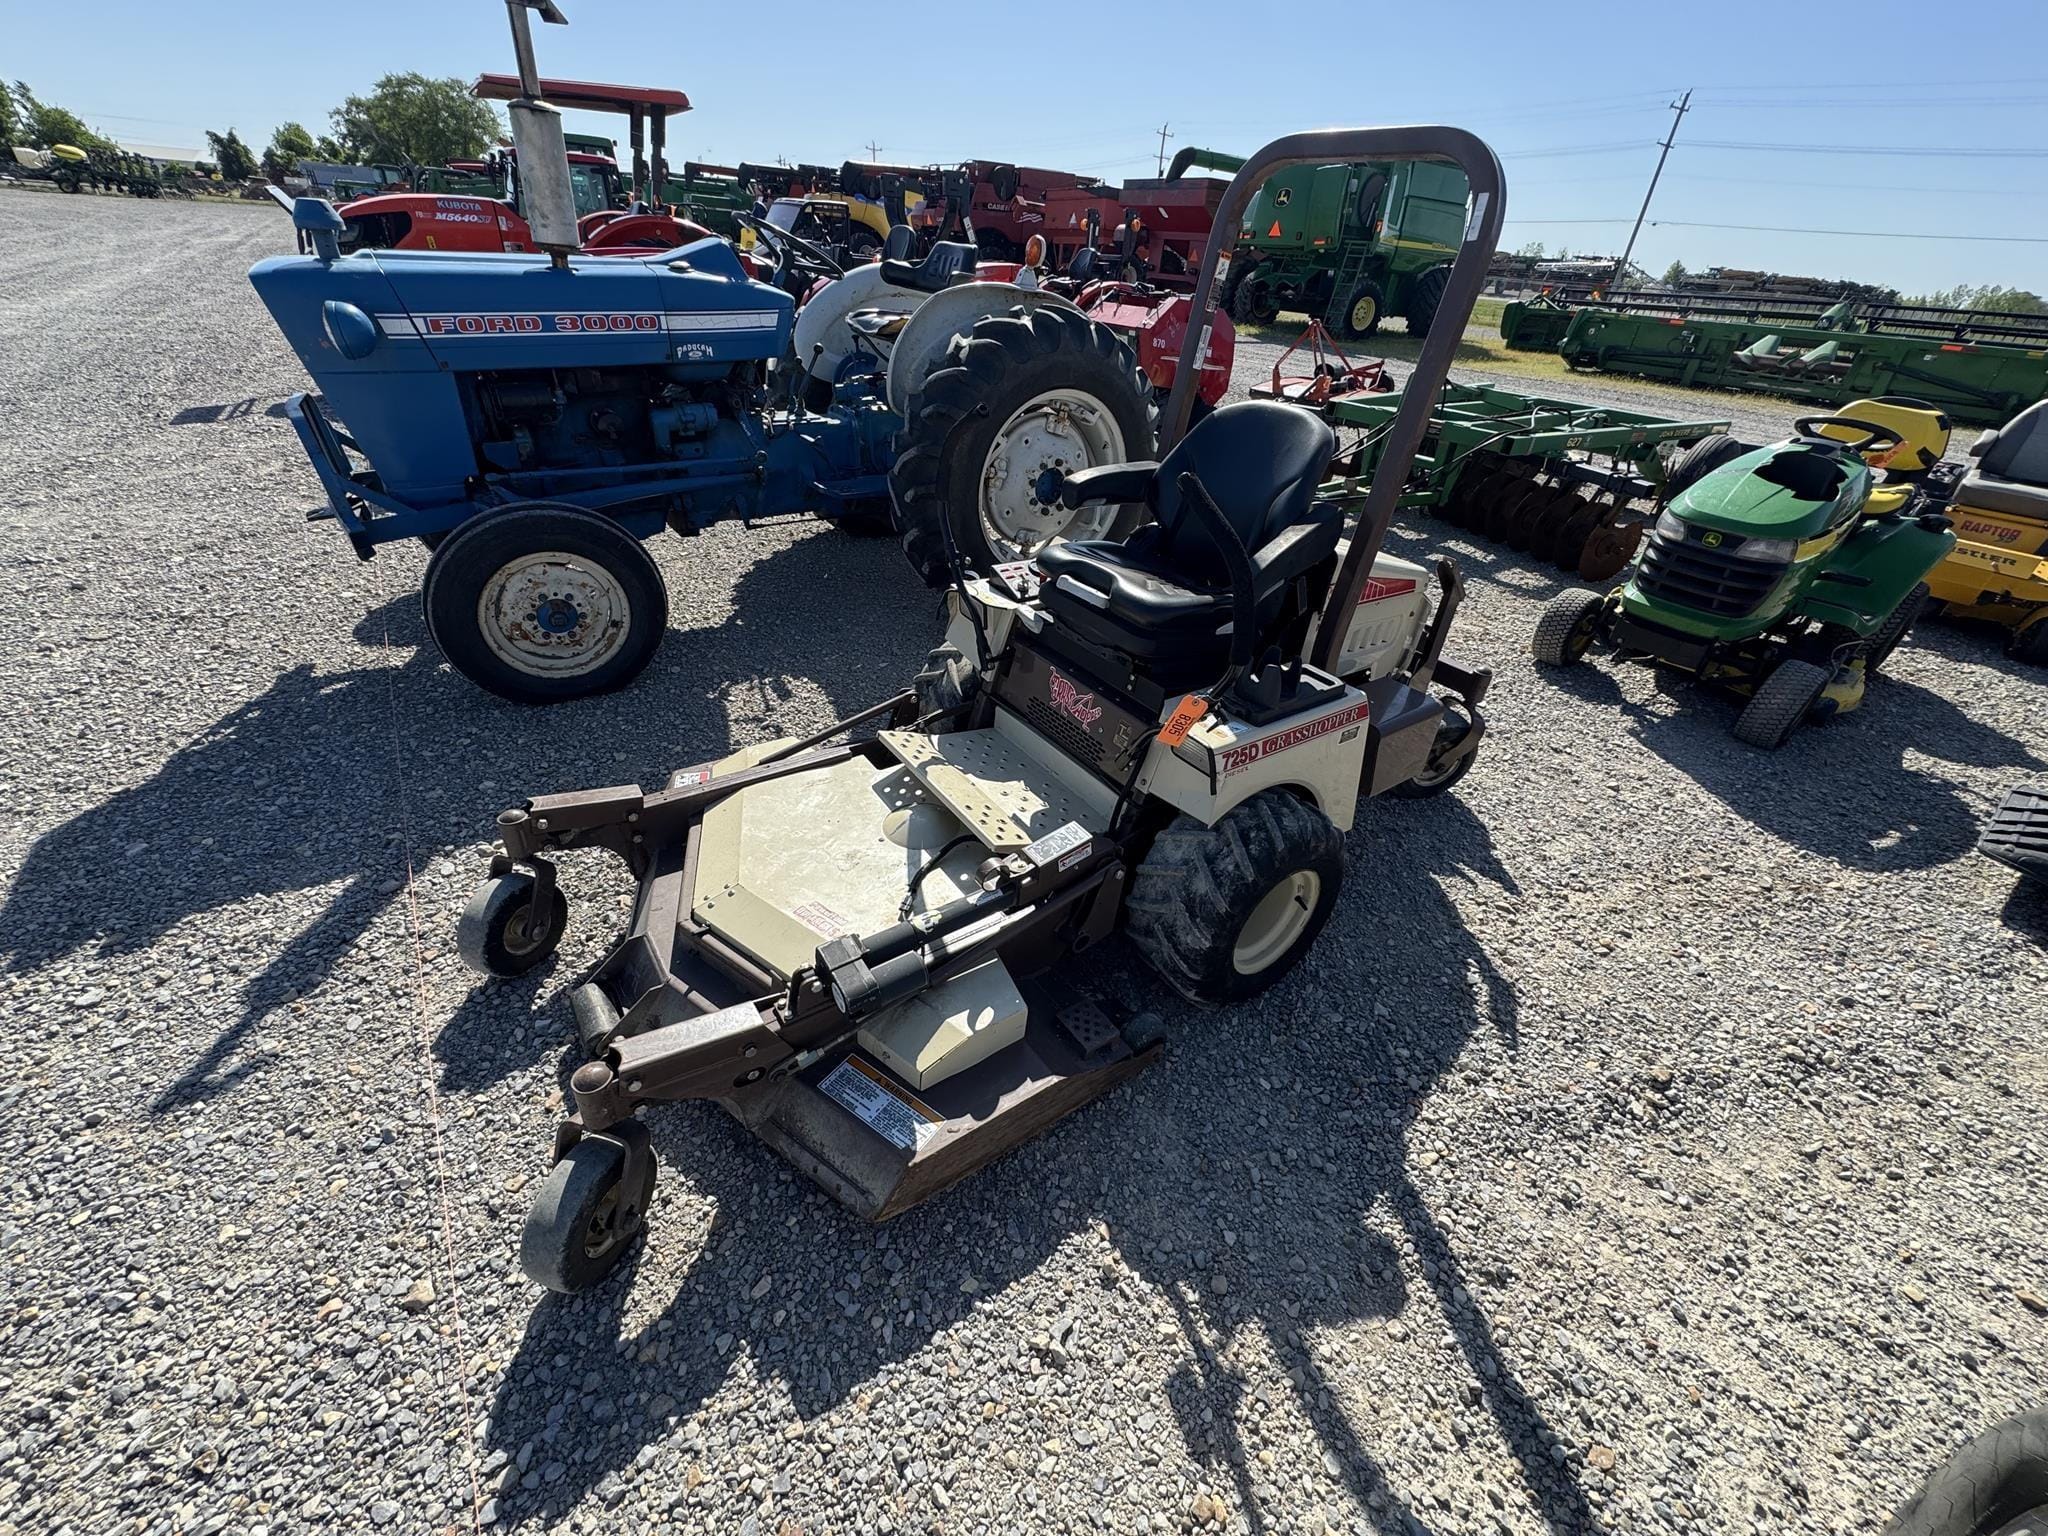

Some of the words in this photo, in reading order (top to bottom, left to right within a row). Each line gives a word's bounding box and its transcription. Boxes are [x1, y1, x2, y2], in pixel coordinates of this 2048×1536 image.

[436, 199, 482, 212] KUBOTA
[987, 202, 1004, 211] CASE
[426, 315, 543, 334] FORD
[554, 314, 659, 332] 3000
[676, 343, 714, 359] PADUCAH
[1152, 337, 1166, 349] 870
[1659, 430, 1674, 439] JOHN
[1674, 428, 1691, 437] DEERE
[1566, 437, 1583, 448] 627
[1960, 520, 2022, 539] RAPTOR
[1953, 546, 2017, 566] STLER
[1168, 713, 1192, 737] 8305
[1222, 742, 1260, 773] 725D
[1266, 707, 1360, 753] GRASSHOPPER
[1224, 766, 1249, 779] DIESEL
[883, 1081, 914, 1106] WARNING
